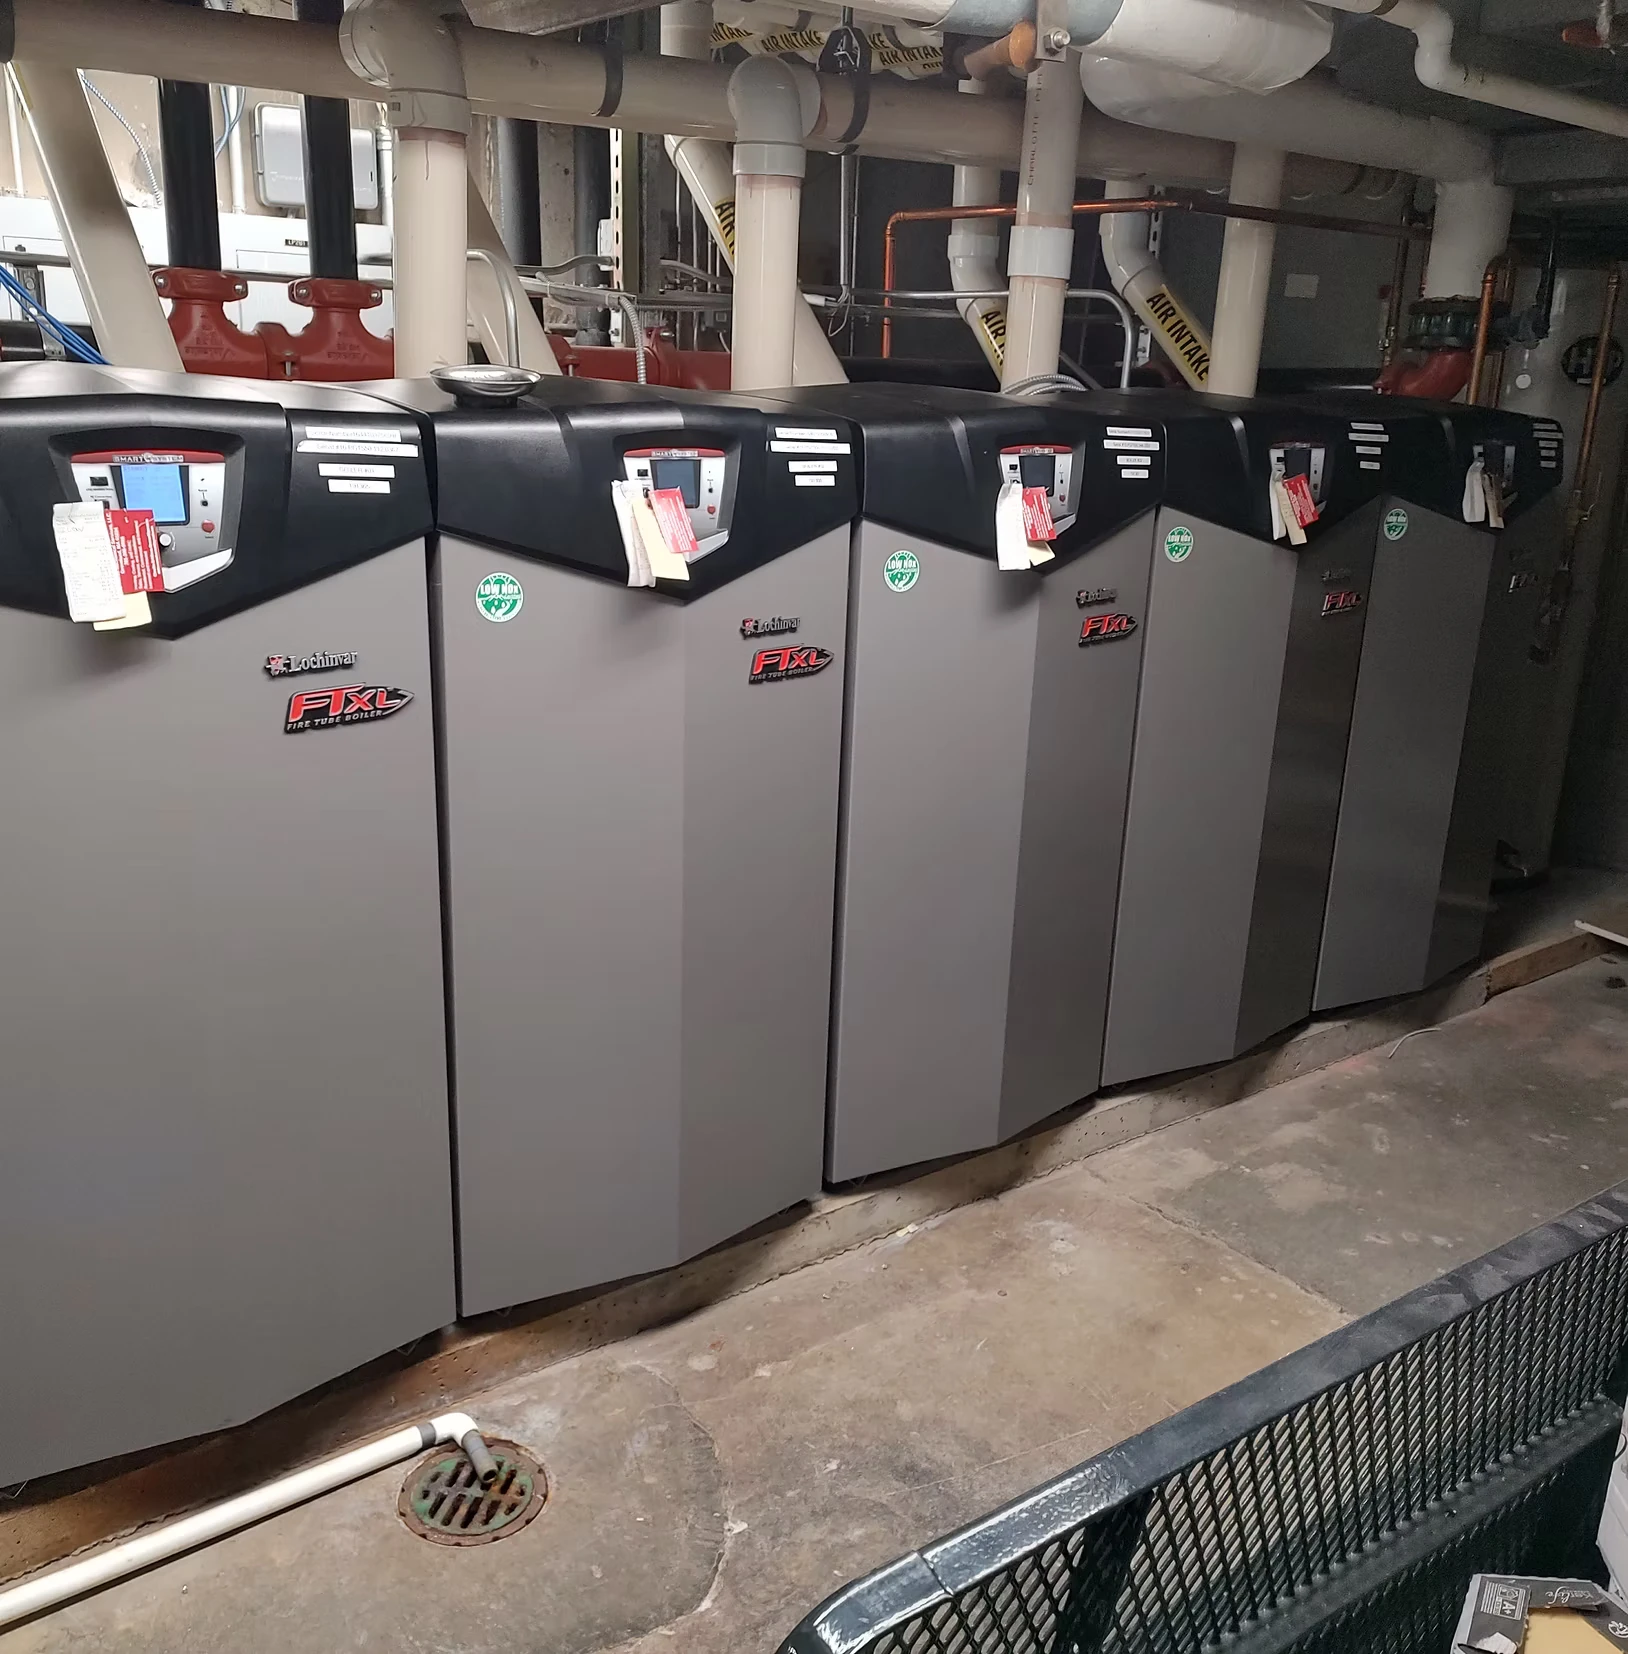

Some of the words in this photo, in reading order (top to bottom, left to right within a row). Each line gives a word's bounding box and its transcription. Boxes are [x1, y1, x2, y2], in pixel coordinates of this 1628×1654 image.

[761, 35, 784, 52] AIR
[780, 30, 825, 50] INTAKE
[880, 48, 902, 66] AIR
[1146, 292, 1176, 325] AIR
[981, 310, 1006, 340] AIR
[480, 583, 500, 595] LOW
[287, 650, 358, 673] Lochinvar
[287, 720, 311, 731] FIRE
[314, 715, 340, 727] TUBE
[345, 709, 384, 722] BOILER
